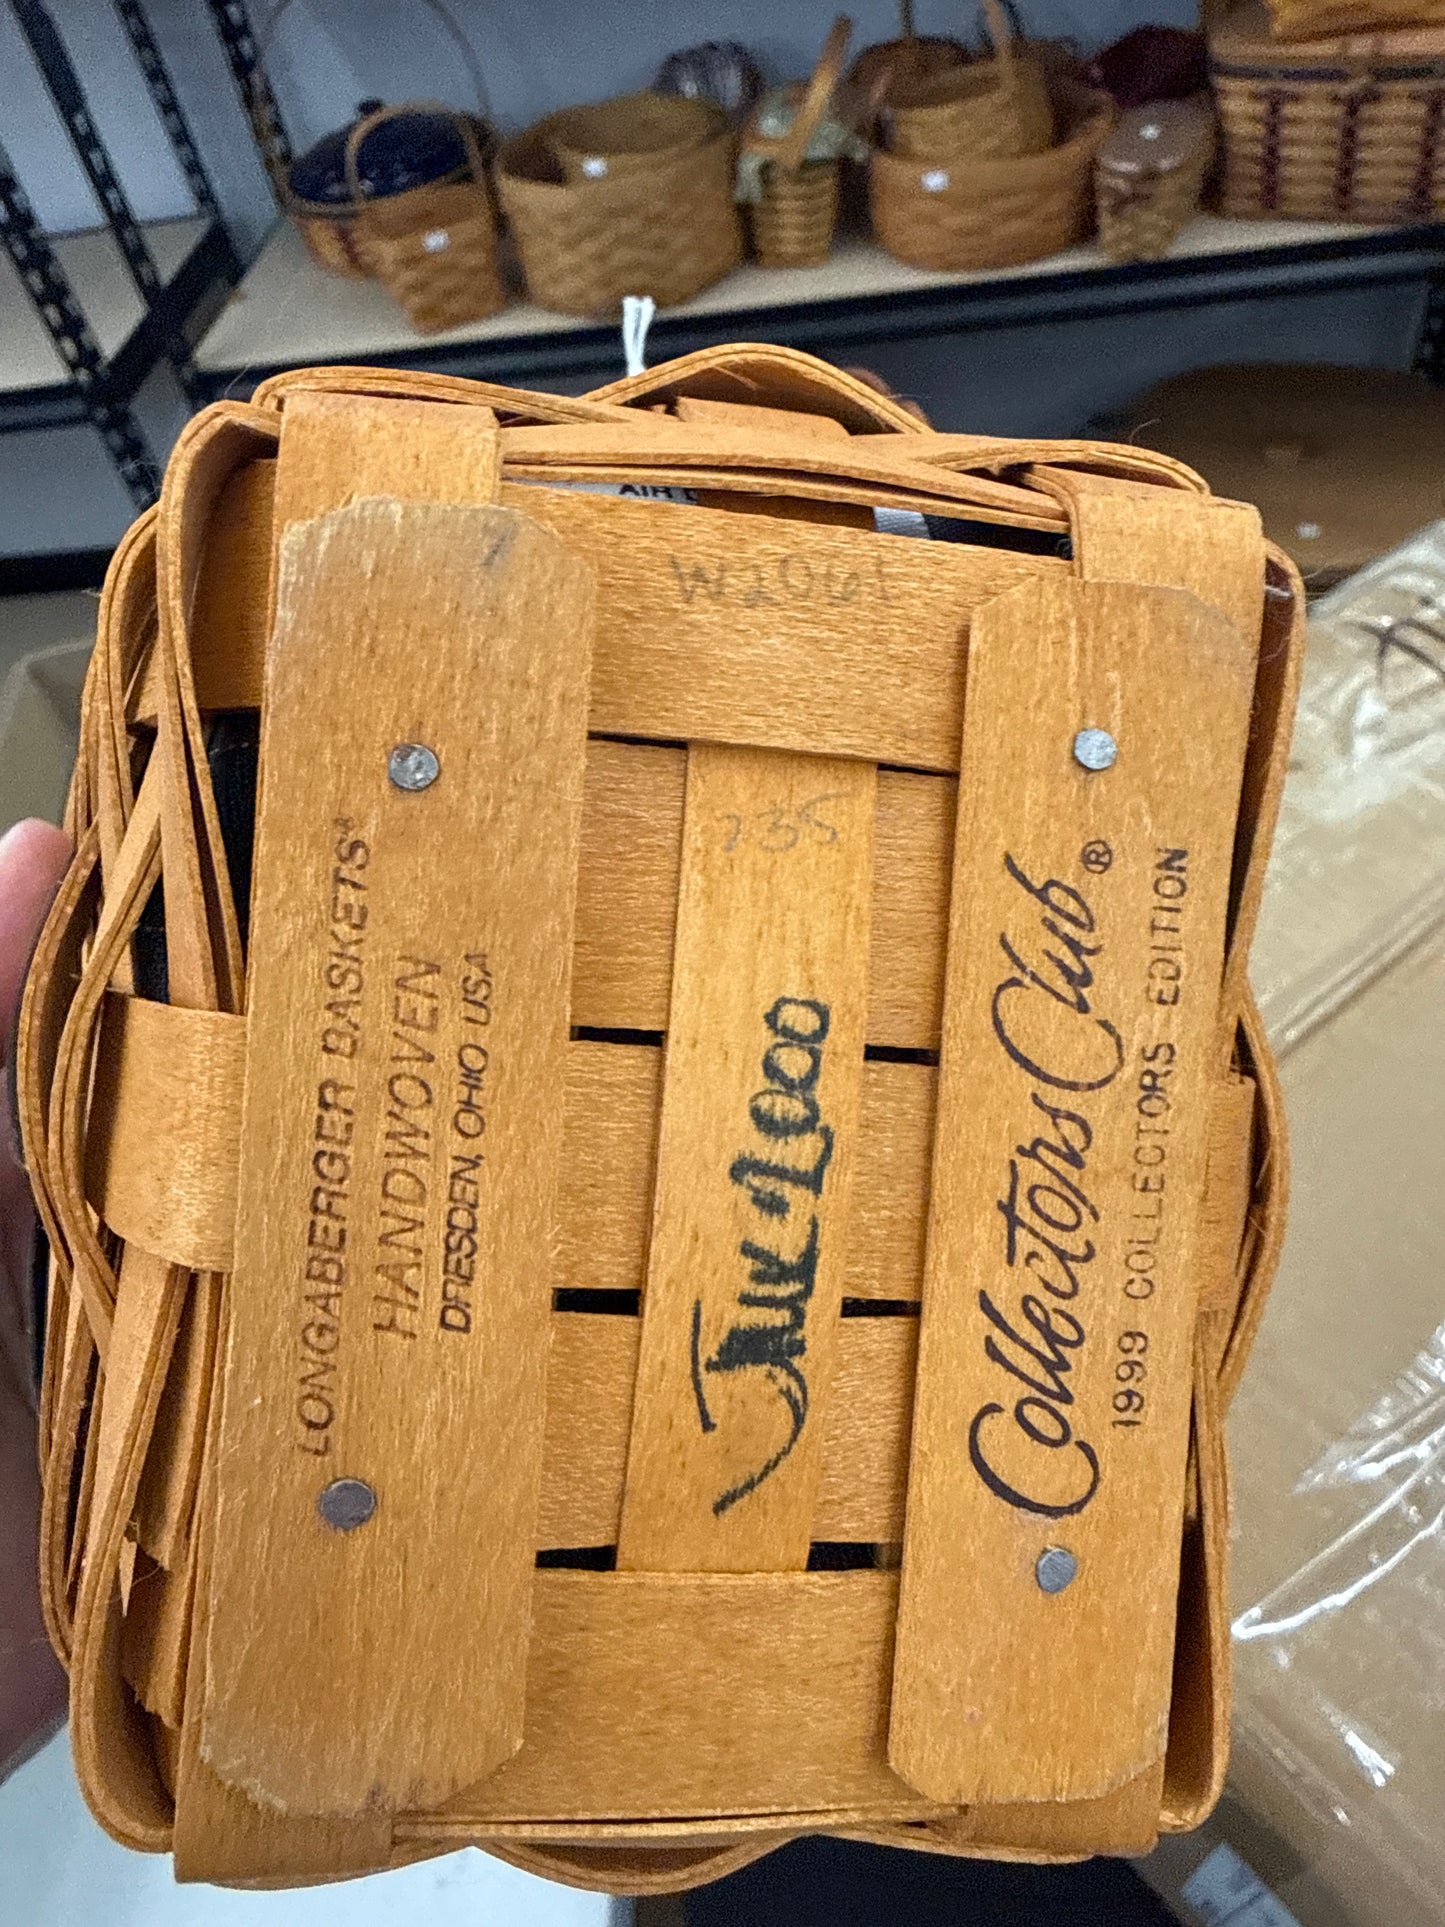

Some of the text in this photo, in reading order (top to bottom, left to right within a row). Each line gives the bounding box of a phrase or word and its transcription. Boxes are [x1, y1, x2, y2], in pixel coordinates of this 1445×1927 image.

[373, 954, 440, 1339] HANDWOVEN
[453, 1044, 488, 1138] OHIO
[462, 953, 492, 1026] USA
[1111, 849, 1188, 1429] 1999 COLLECTORS EDITION
[299, 1078, 355, 1456] LONGABERGER
[969, 1092, 1101, 1519] Collectors
